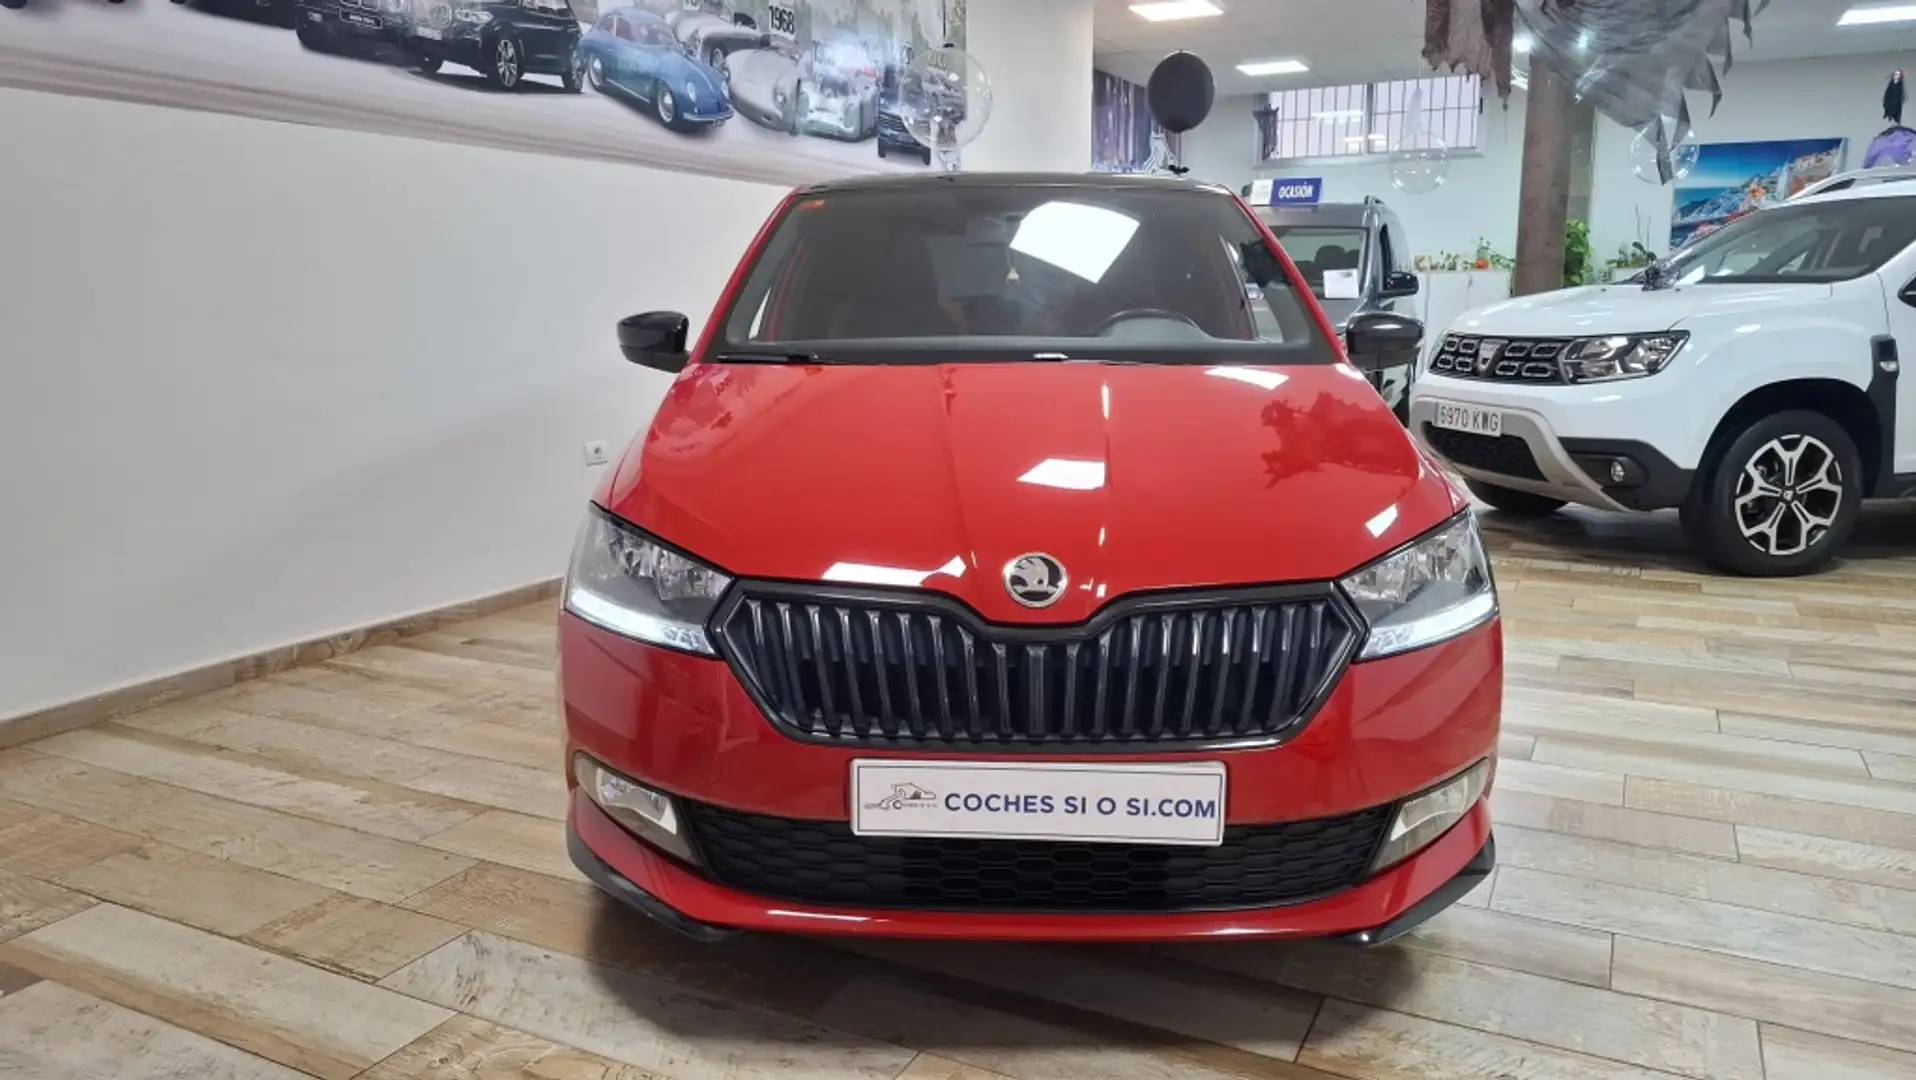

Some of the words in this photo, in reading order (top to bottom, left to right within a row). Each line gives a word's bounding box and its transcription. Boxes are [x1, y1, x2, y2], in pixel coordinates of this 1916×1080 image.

[768, 5, 795, 34] 1968
[1278, 181, 1314, 199] OCASIÓN
[1440, 405, 1468, 428] 6970
[944, 793, 1054, 813] COCHES
[1064, 796, 1086, 814] SI
[1097, 797, 1116, 815] O
[1126, 798, 1215, 818] SI.COM
